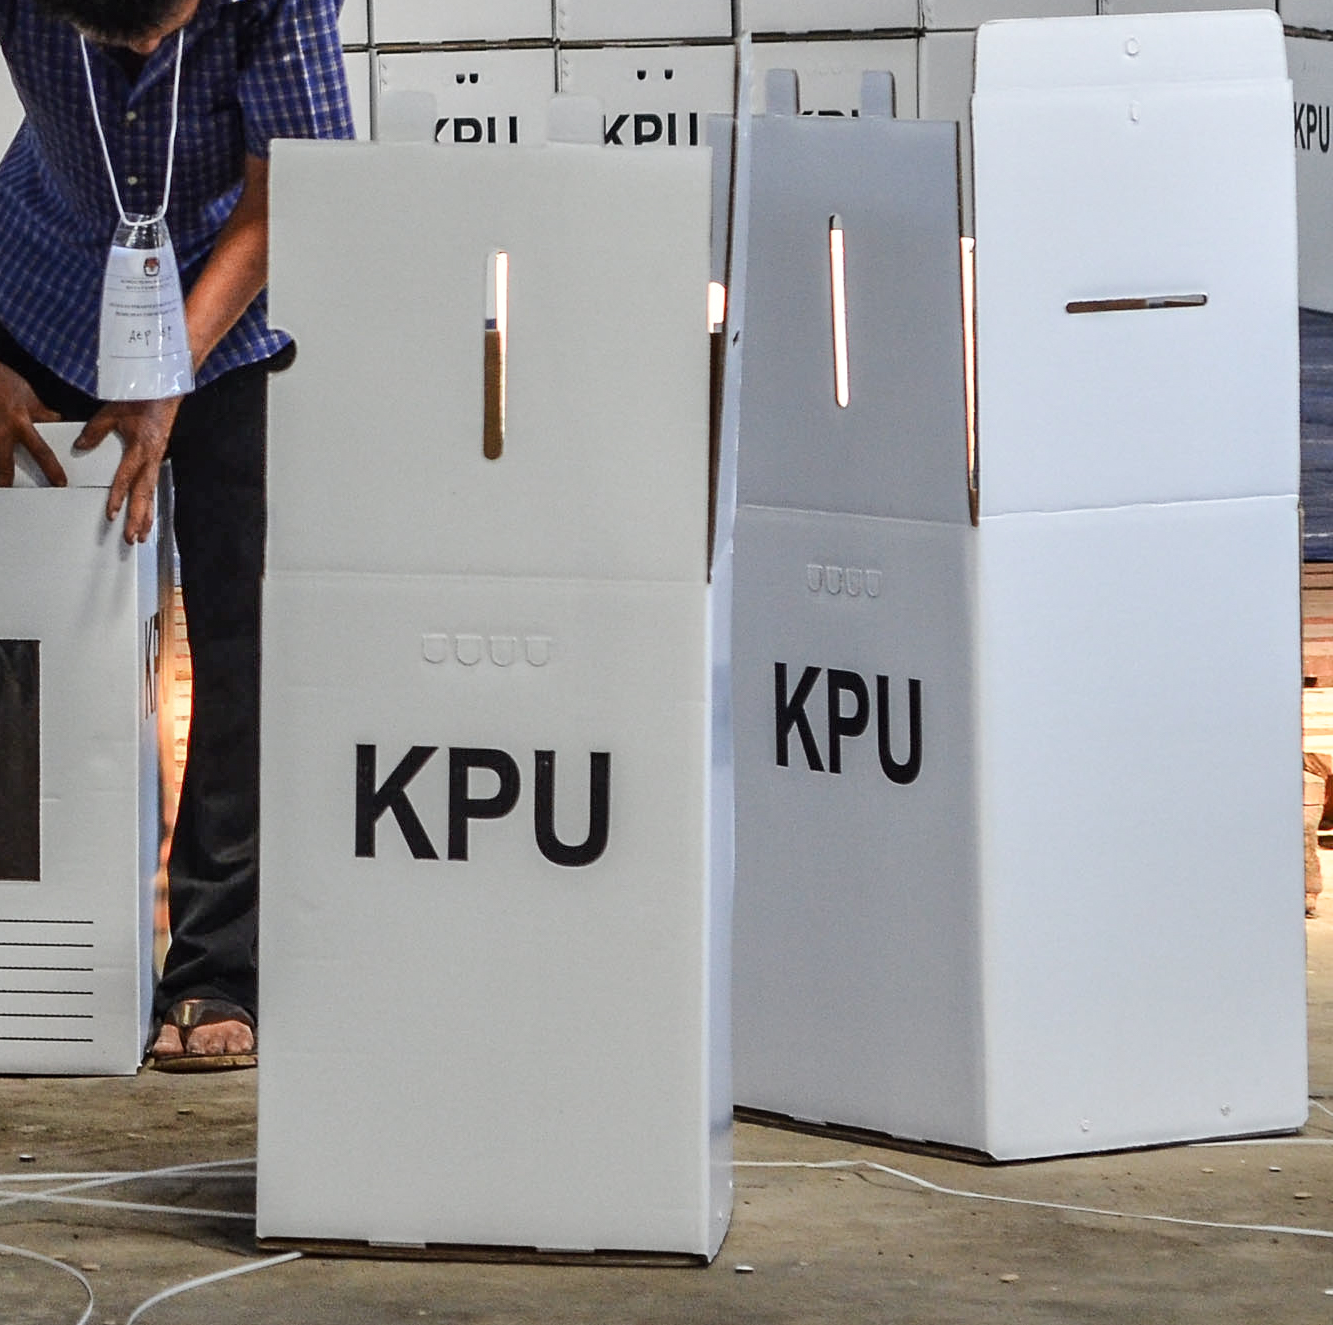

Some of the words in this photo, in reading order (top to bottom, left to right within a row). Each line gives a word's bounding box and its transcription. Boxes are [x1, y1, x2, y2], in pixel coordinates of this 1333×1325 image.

[1294, 101, 1330, 153] KPU
[774, 661, 923, 785] KPU
[354, 743, 611, 868] KPU
